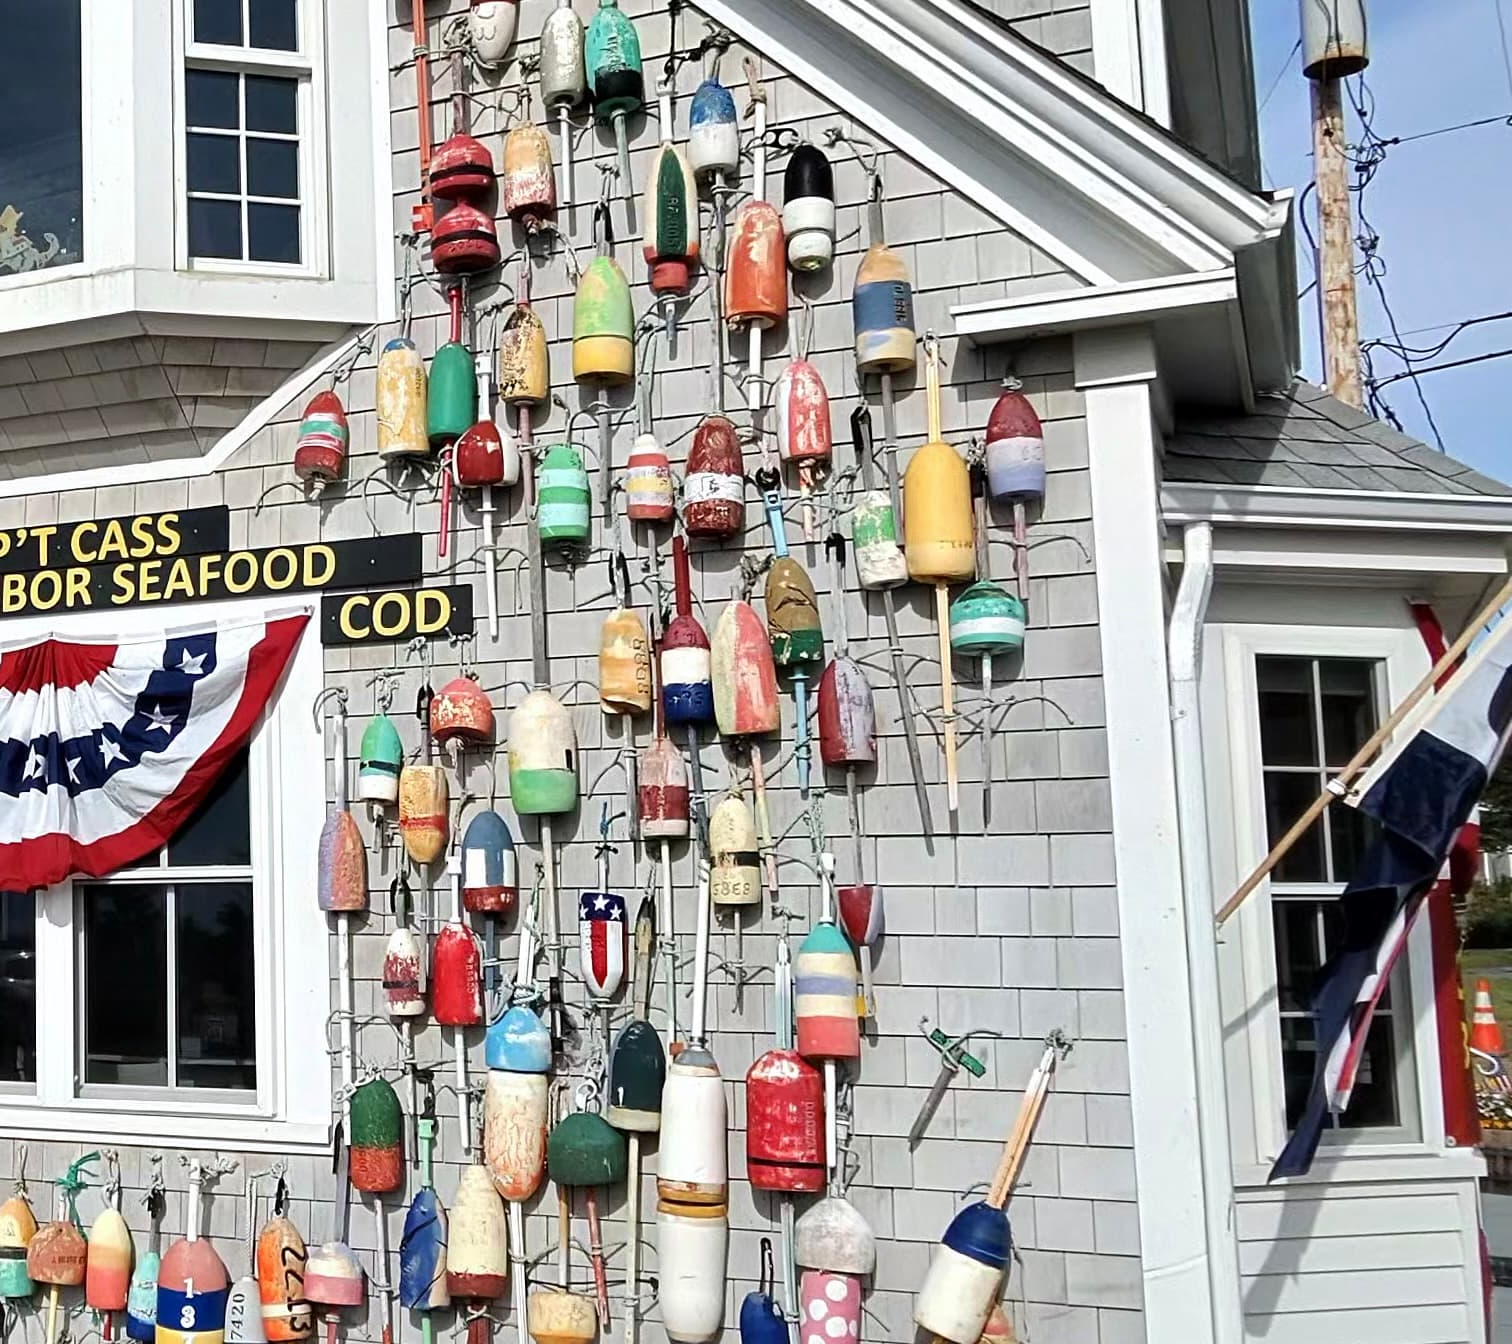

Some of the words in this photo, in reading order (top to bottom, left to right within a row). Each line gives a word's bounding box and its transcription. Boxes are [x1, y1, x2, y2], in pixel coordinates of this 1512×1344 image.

[70, 512, 181, 564] CASS
[110, 543, 337, 606] SEAFOOD
[339, 588, 452, 640] COD
[229, 1292, 246, 1341] 7420
